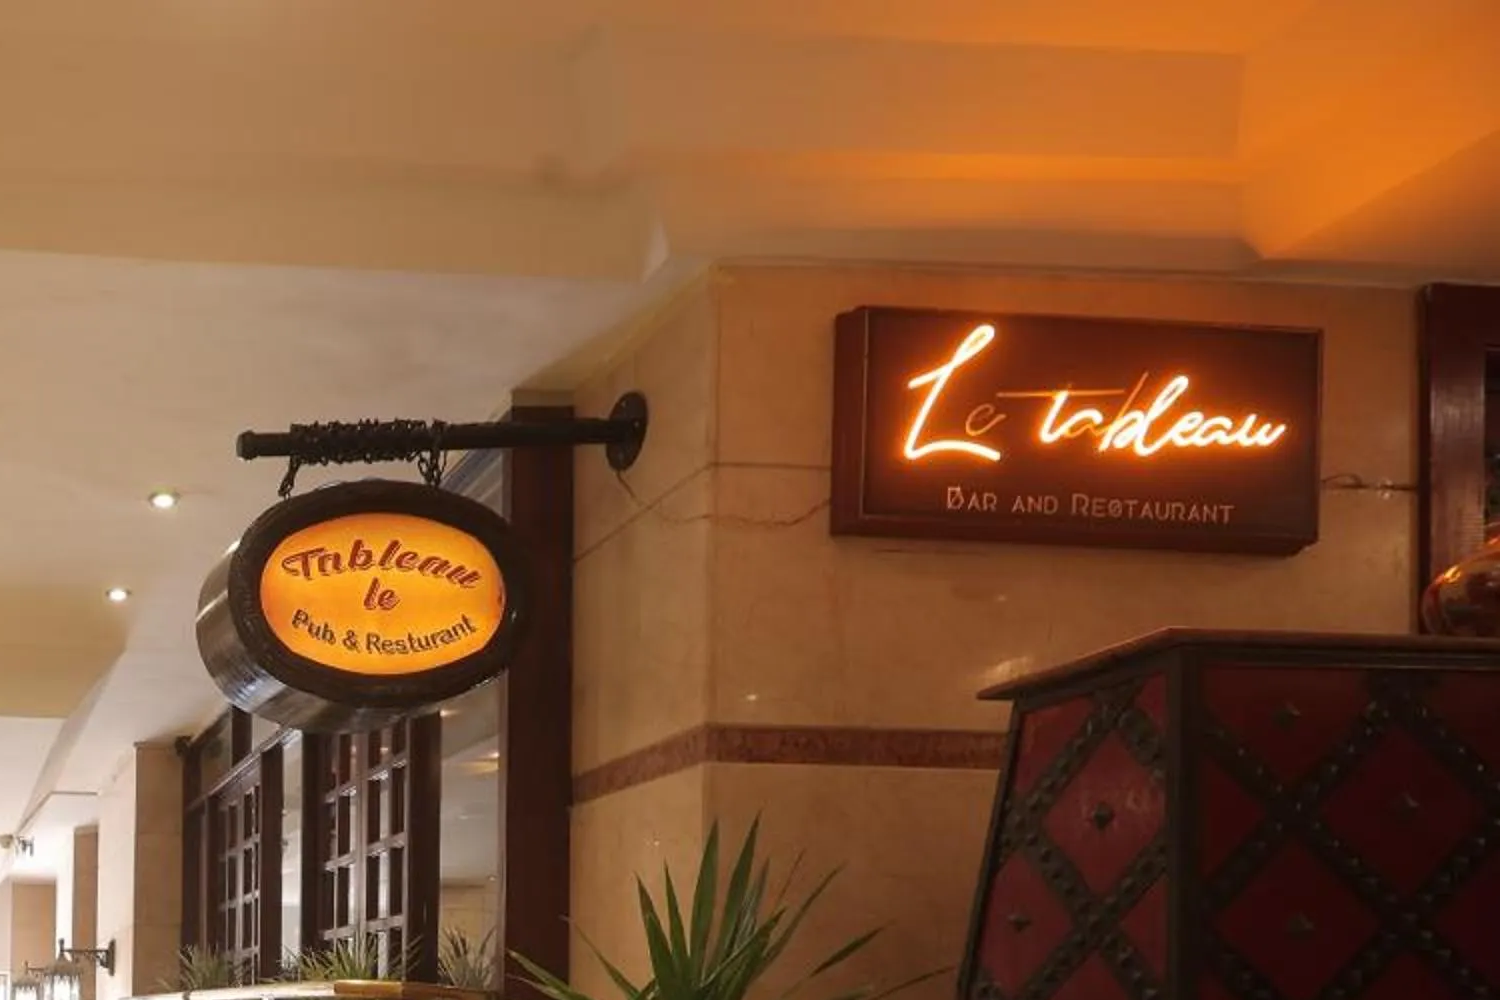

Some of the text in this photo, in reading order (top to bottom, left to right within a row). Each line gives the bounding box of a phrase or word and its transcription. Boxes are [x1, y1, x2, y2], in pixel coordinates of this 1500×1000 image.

[905, 323, 1005, 461] Le
[281, 539, 482, 588] Tableau
[363, 577, 401, 611] le
[291, 608, 477, 655] Pub & Resturant
